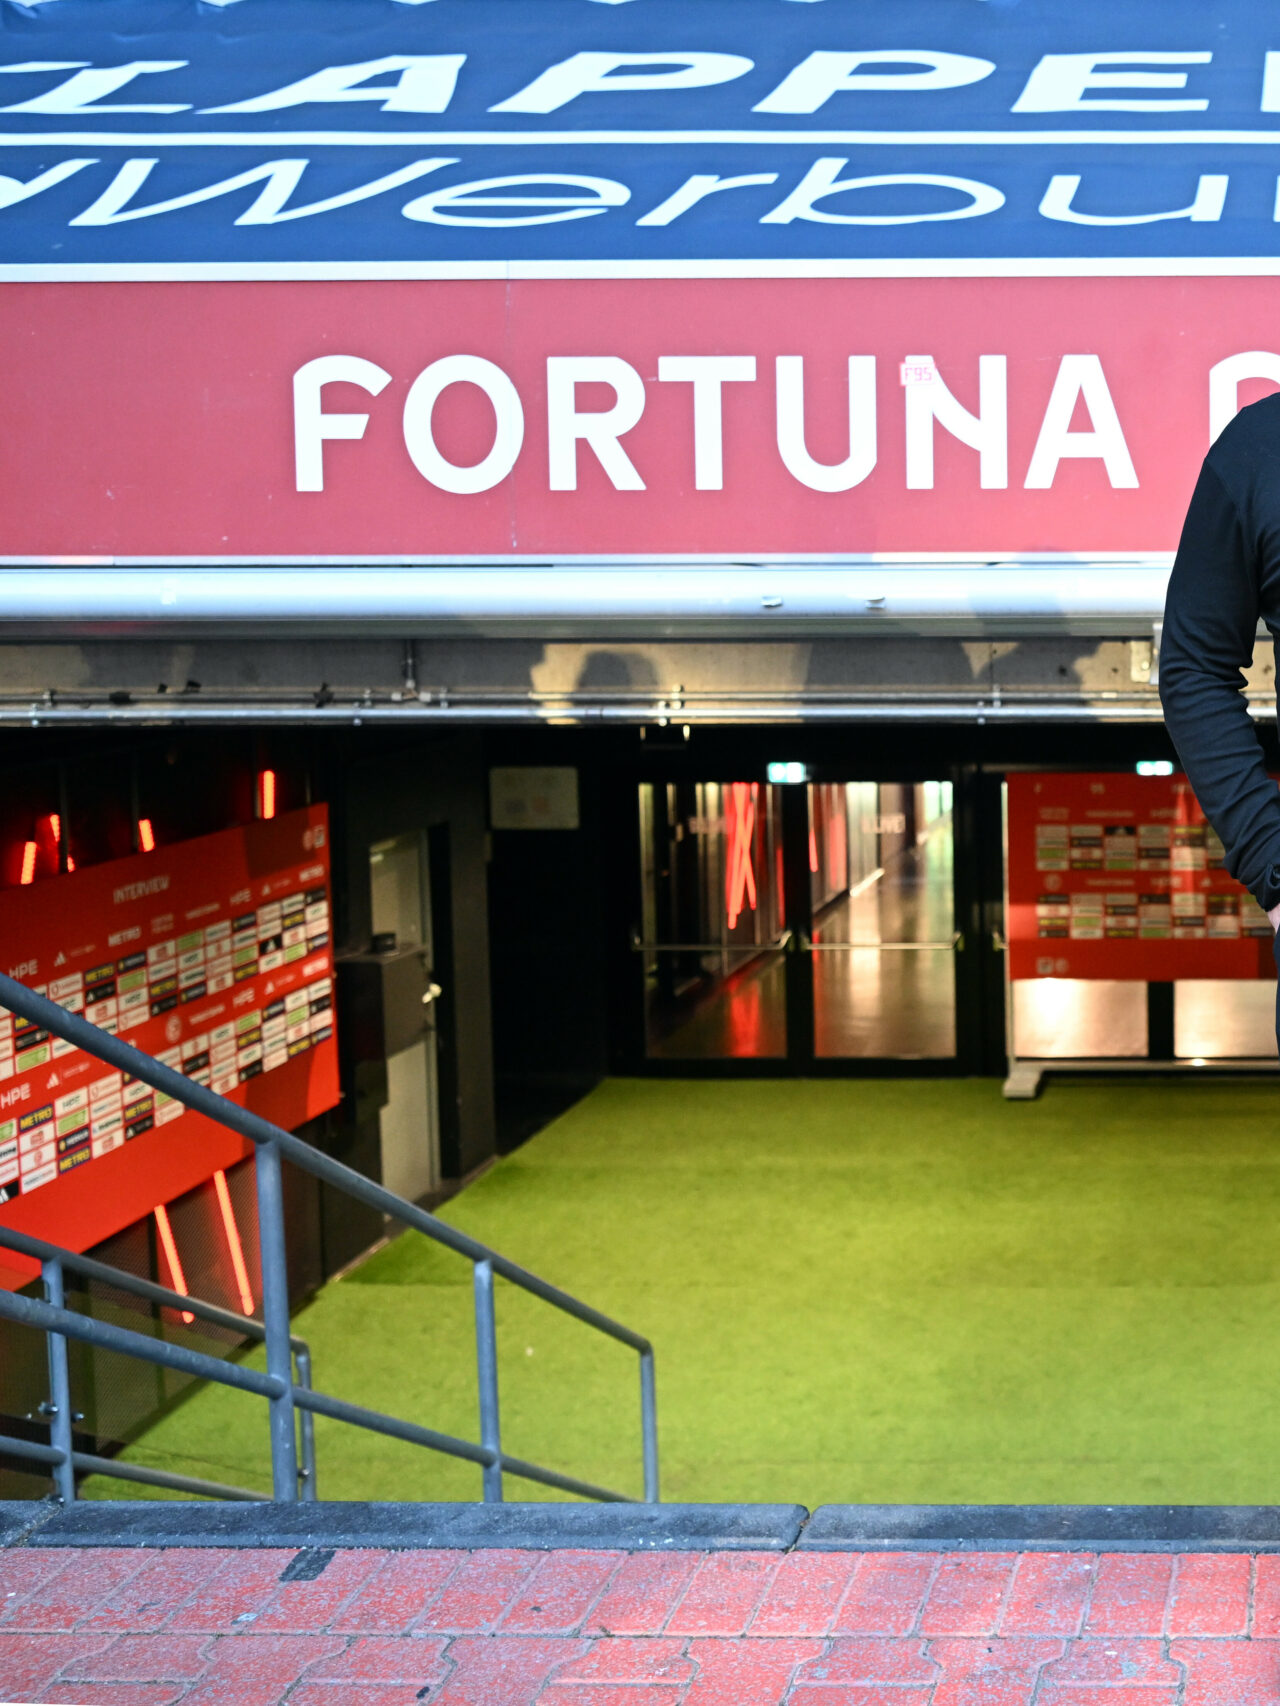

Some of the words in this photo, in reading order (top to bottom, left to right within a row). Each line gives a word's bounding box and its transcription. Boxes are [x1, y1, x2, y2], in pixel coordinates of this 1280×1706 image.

[293, 354, 1140, 494] FORTUNA
[112, 874, 170, 904] INTERVIEW
[107, 925, 142, 948] METRO
[9, 958, 39, 980] HPE
[0, 1083, 32, 1109] HPE
[19, 1106, 53, 1130] METRO
[59, 1147, 91, 1172] METRO
